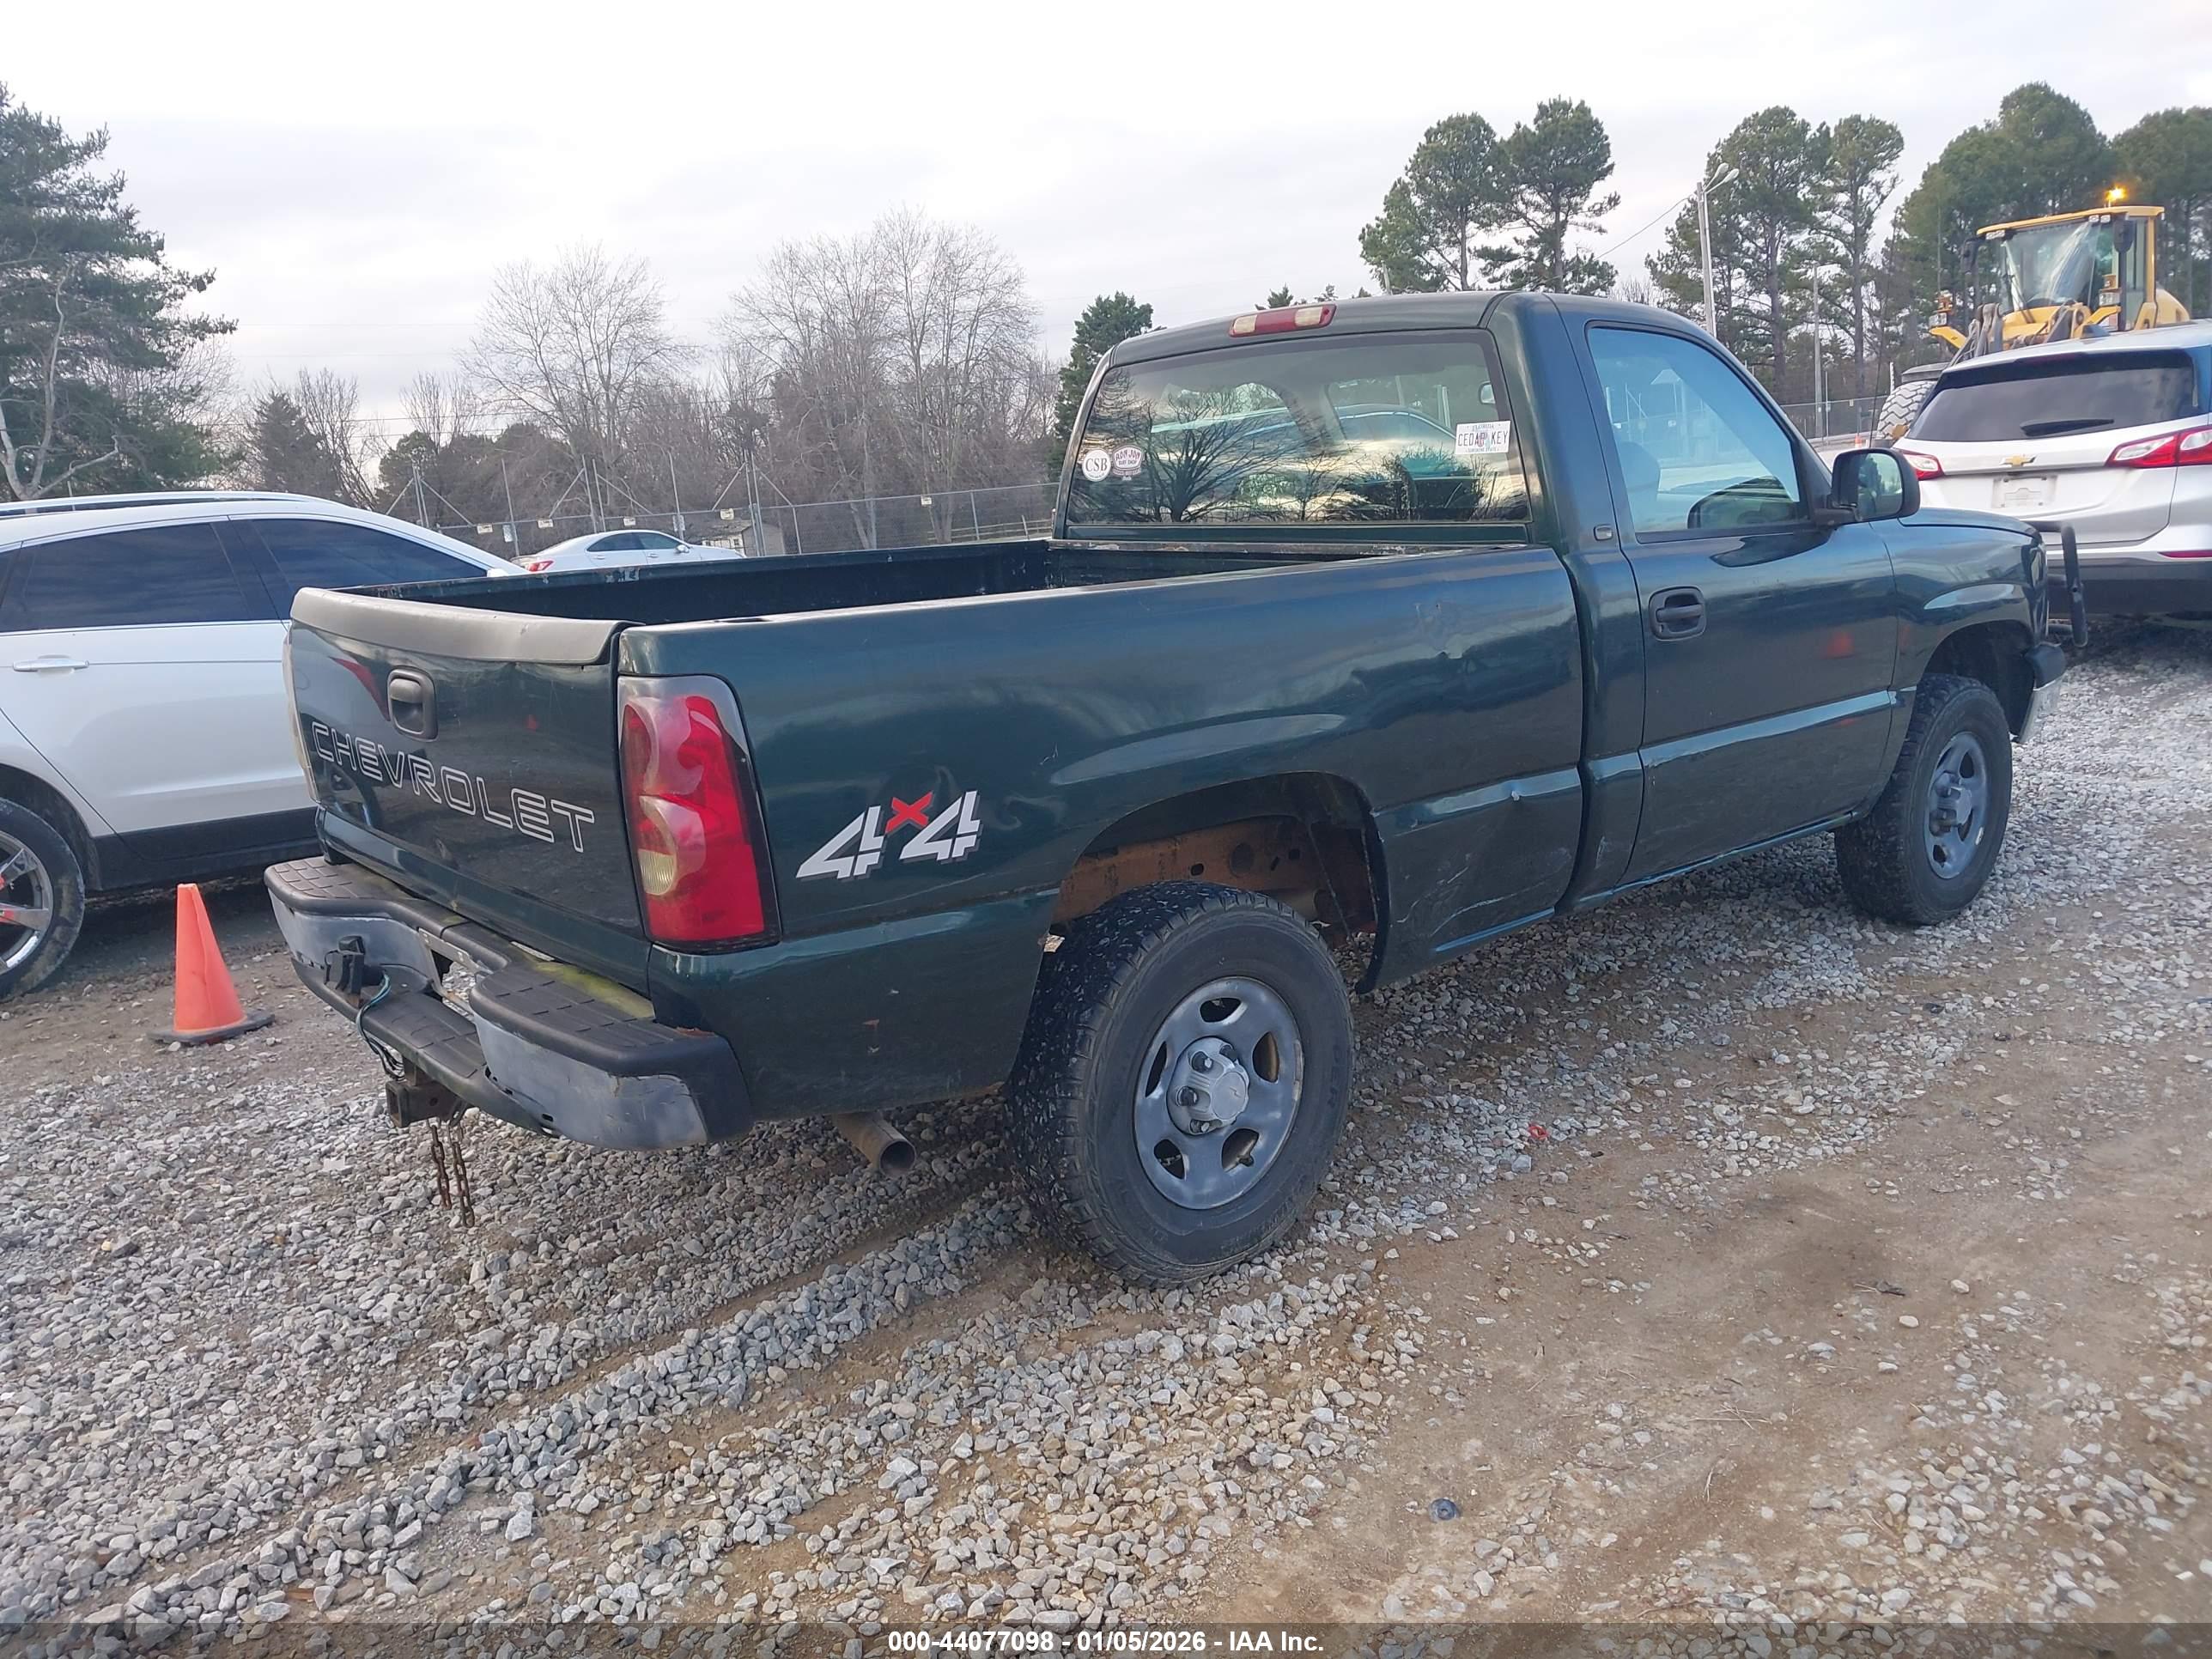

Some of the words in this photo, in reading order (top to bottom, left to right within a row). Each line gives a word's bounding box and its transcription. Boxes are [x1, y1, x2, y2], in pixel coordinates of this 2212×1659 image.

[1457, 432, 1486, 447] CEDAR
[1491, 430, 1509, 445] KEY
[1085, 458, 1108, 472] CSB
[312, 721, 595, 854] CHEVROLET
